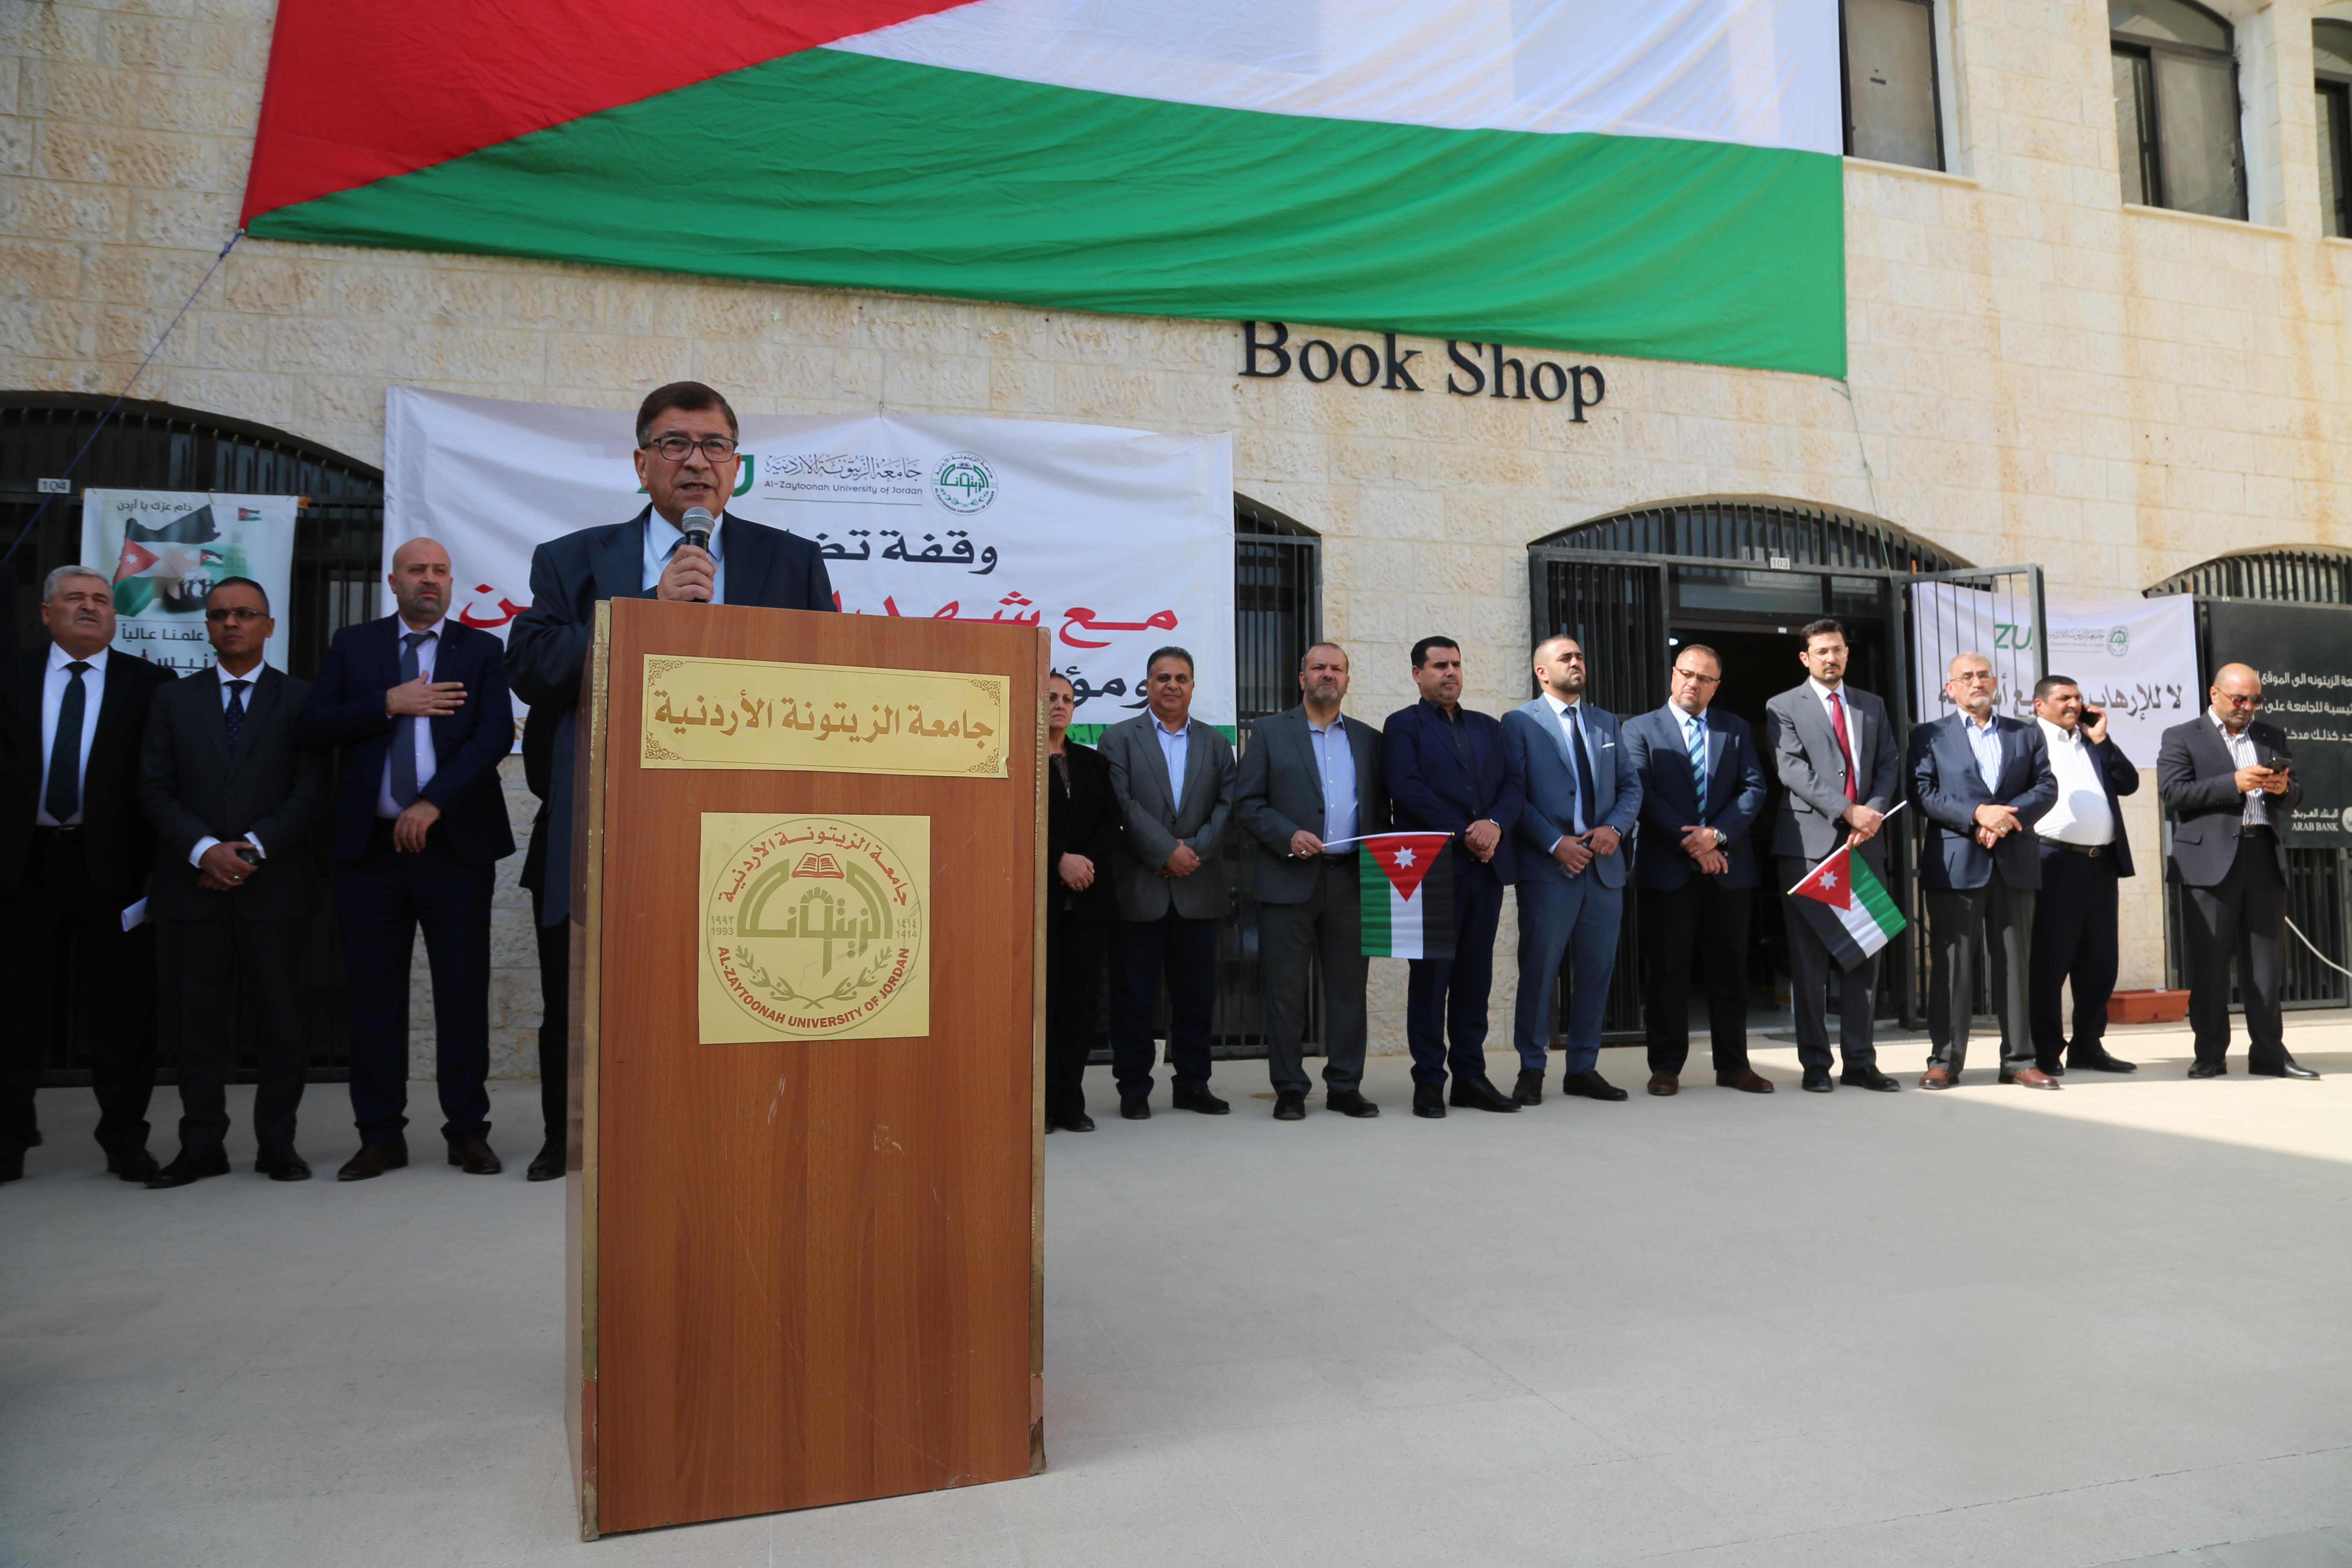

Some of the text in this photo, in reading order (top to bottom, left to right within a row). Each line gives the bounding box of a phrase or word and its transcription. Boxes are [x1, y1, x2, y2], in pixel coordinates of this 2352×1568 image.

[1238, 321, 1605, 422] Book Shop
[41, 480, 67, 490] 104
[764, 481, 829, 491] Al-Zaytoonah
[833, 485, 877, 494] University
[892, 486, 922, 494] Jordan
[140, 501, 148, 511] يا
[174, 503, 192, 512] دام
[879, 529, 998, 575] وقفة
[1773, 559, 1788, 568] 103
[162, 628, 204, 641] علمنا
[1059, 607, 1178, 648] مع
[1995, 624, 2033, 650] ZU
[2261, 671, 2290, 686] الموقع
[2167, 683, 2183, 709] لا
[2265, 699, 2285, 714] على
[2287, 700, 2323, 715] للجامعة
[653, 689, 994, 750] جامعة الزيتونة الأردنية
[2311, 728, 2339, 741] كذلك
[2292, 822, 2339, 832] ARAB BANK
[717, 826, 908, 906] جامعة الزيتونة الأردنية
[710, 927, 734, 936] 1993
[896, 929, 918, 938] 1414
[718, 946, 910, 1029] AL-ZAYTOONAH UNIVERSITY OF JORDAN
